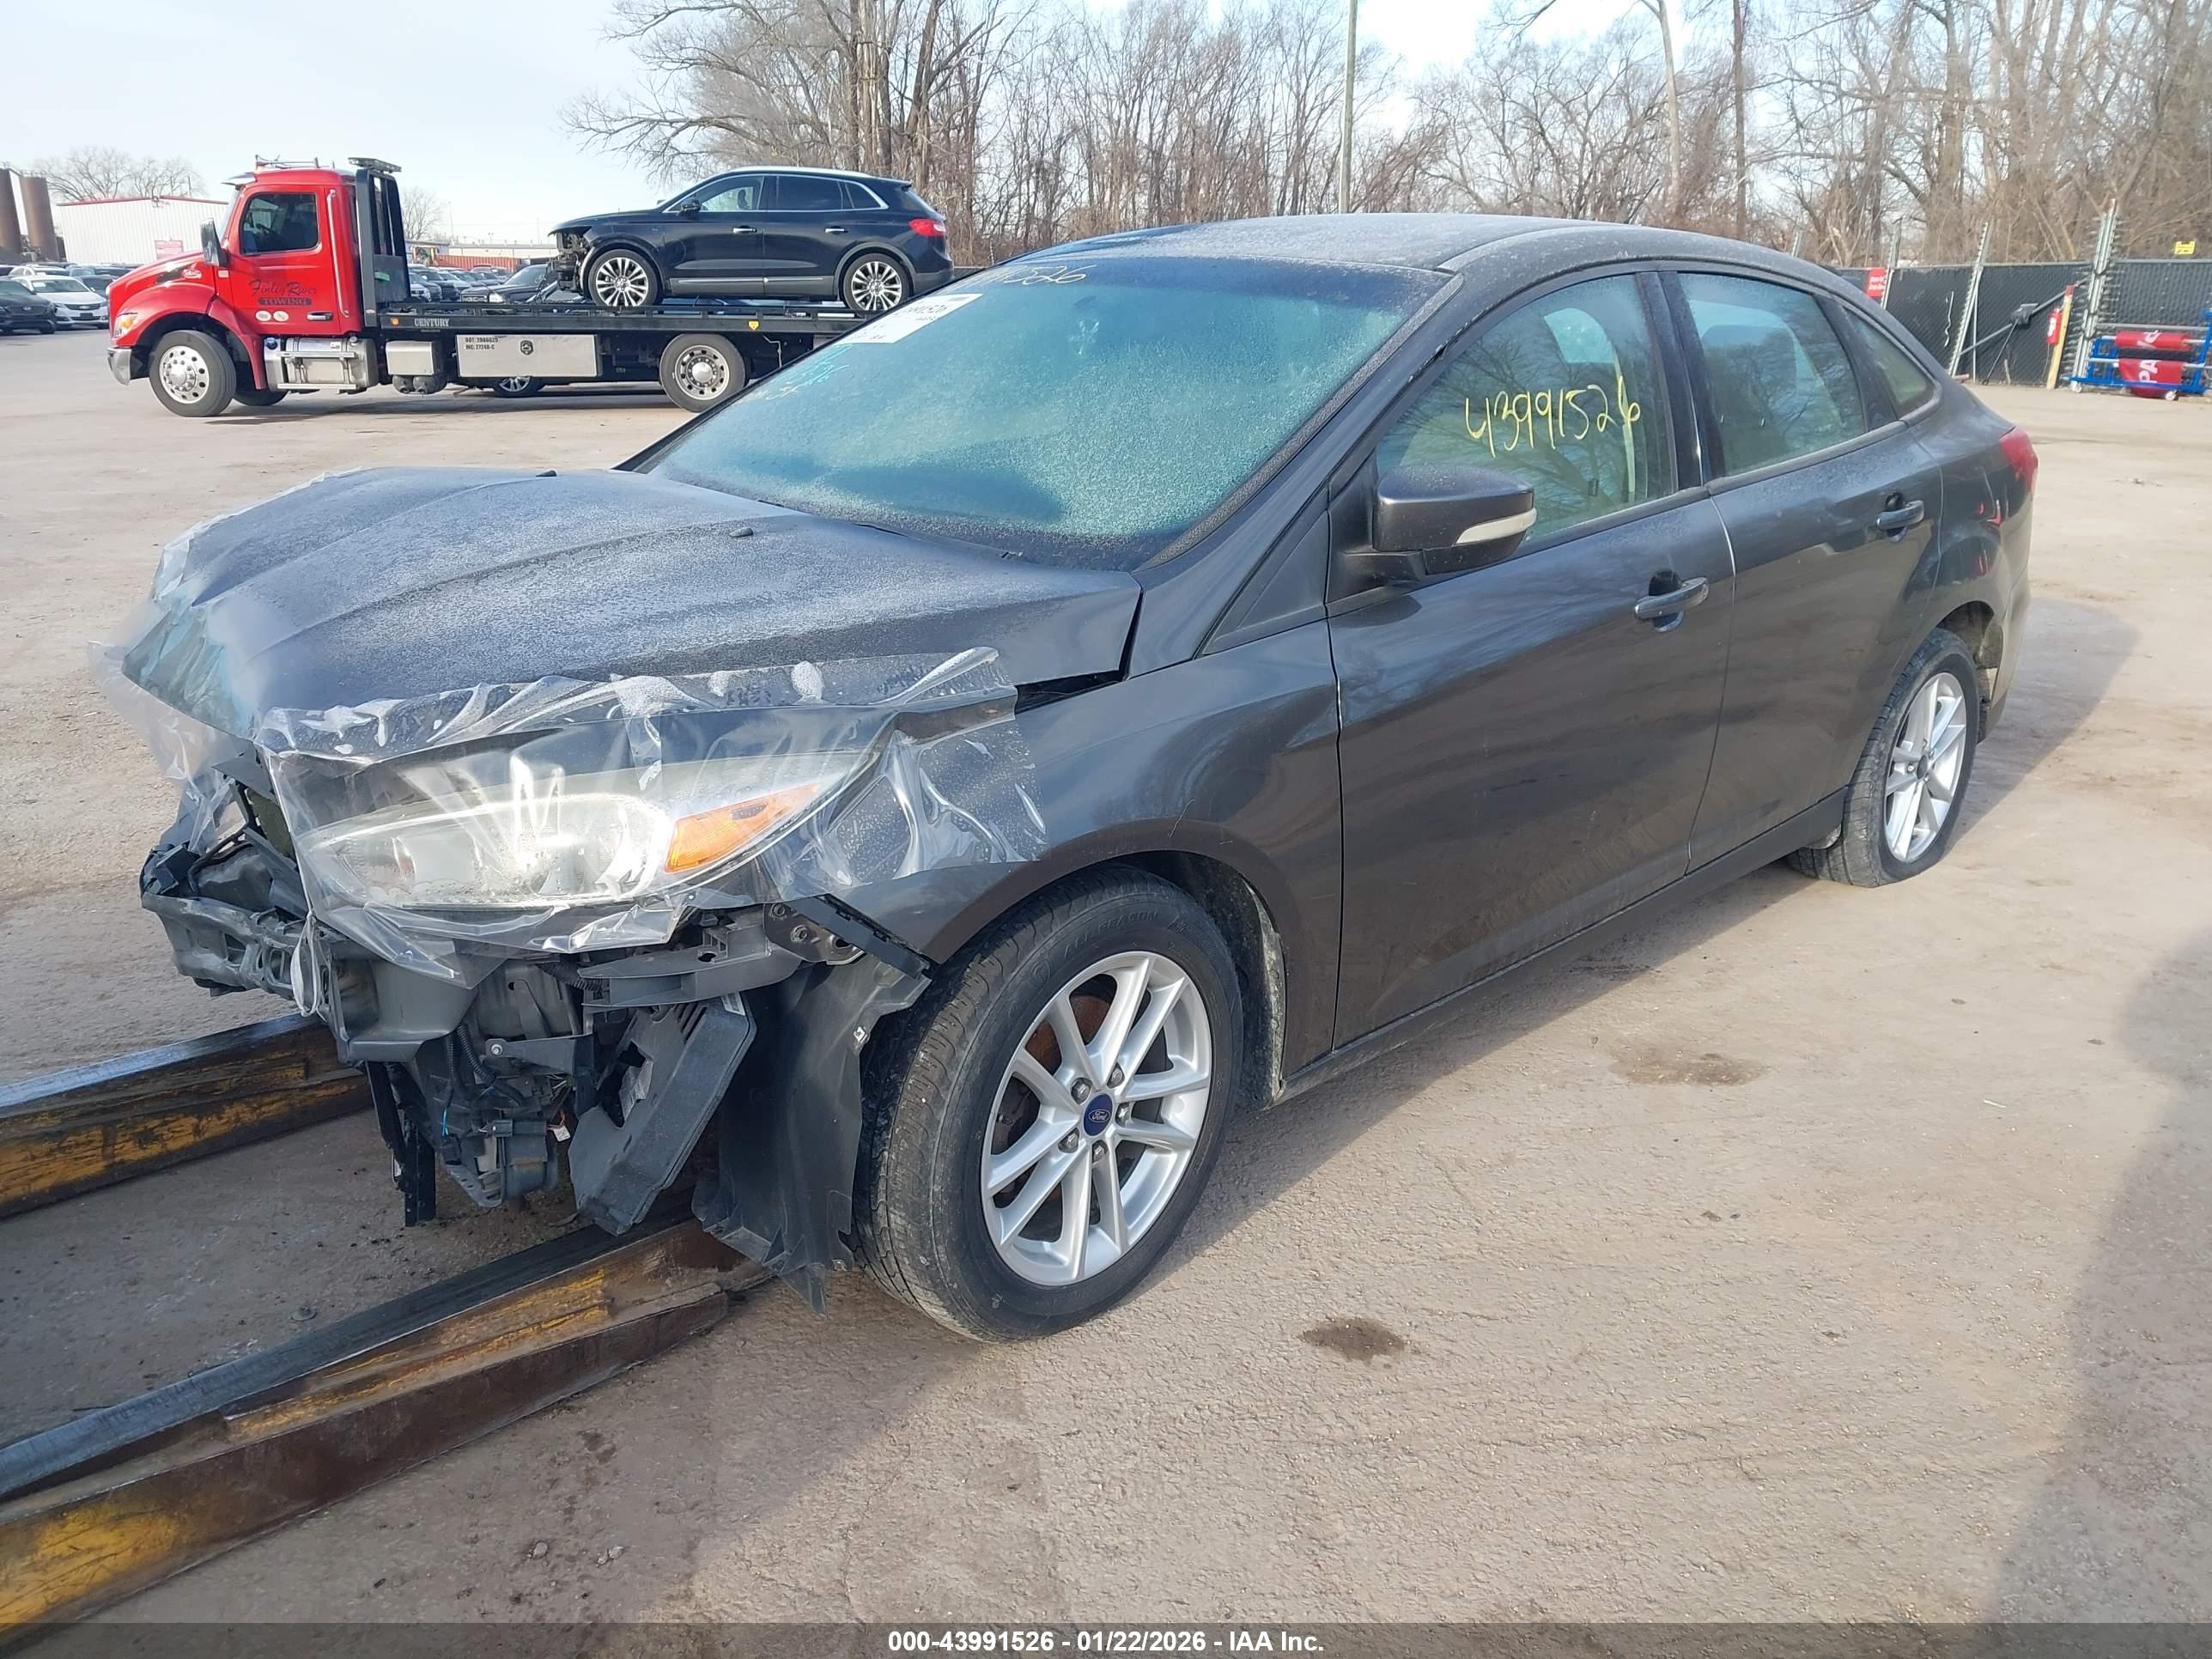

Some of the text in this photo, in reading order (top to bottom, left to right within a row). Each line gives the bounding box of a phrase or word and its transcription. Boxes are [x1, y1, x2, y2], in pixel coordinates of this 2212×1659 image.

[263, 297, 307, 306] TOWING
[414, 318, 450, 327] CENTURY
[1464, 375, 1642, 459] 43991526
[1091, 1111, 1108, 1121] Ford
